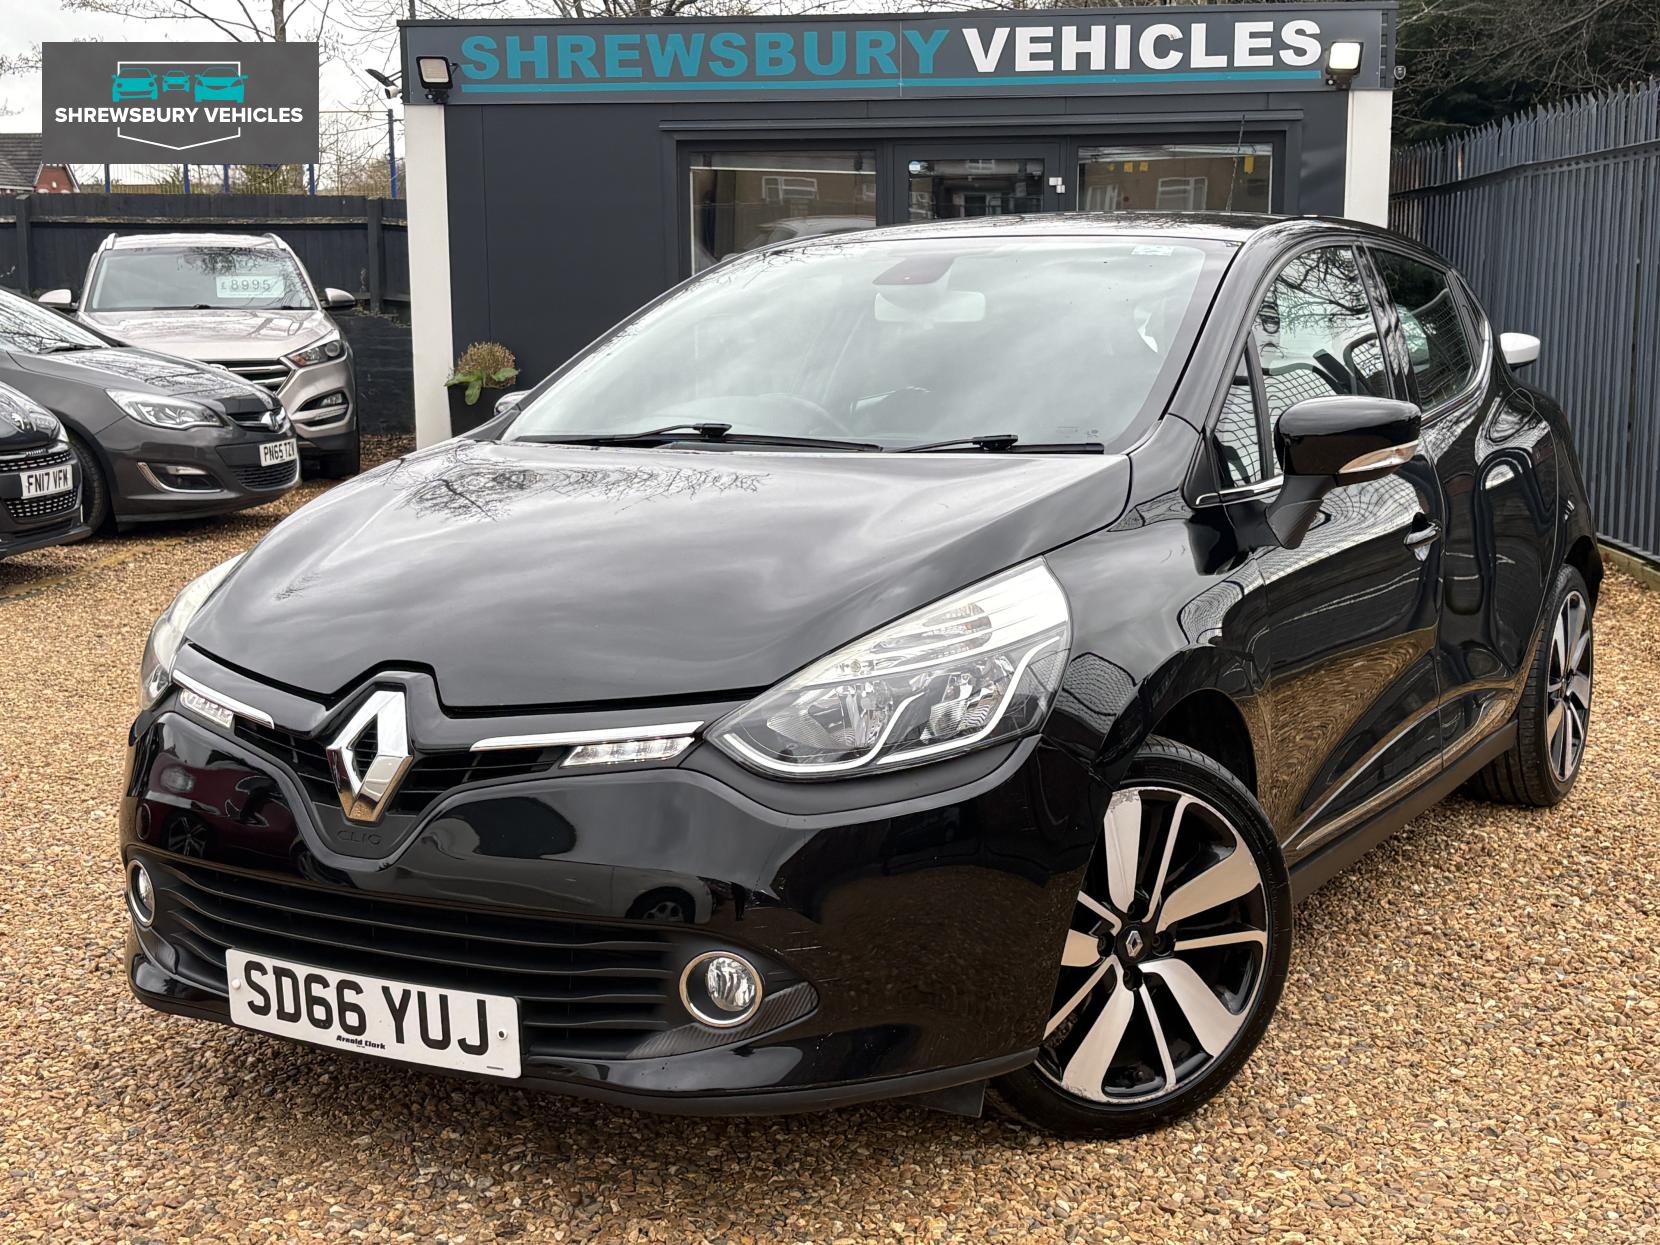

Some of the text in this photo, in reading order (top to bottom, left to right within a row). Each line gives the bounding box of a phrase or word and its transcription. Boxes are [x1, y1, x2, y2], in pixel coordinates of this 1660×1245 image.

[461, 19, 1322, 80] SHREWSBURY VEHICLES
[263, 443, 284, 462] PN65
[27, 472, 50, 494] FN17
[244, 960, 490, 1056] SD66 YUJ
[336, 1034, 363, 1046] Arnold
[364, 1040, 386, 1050] Clark
